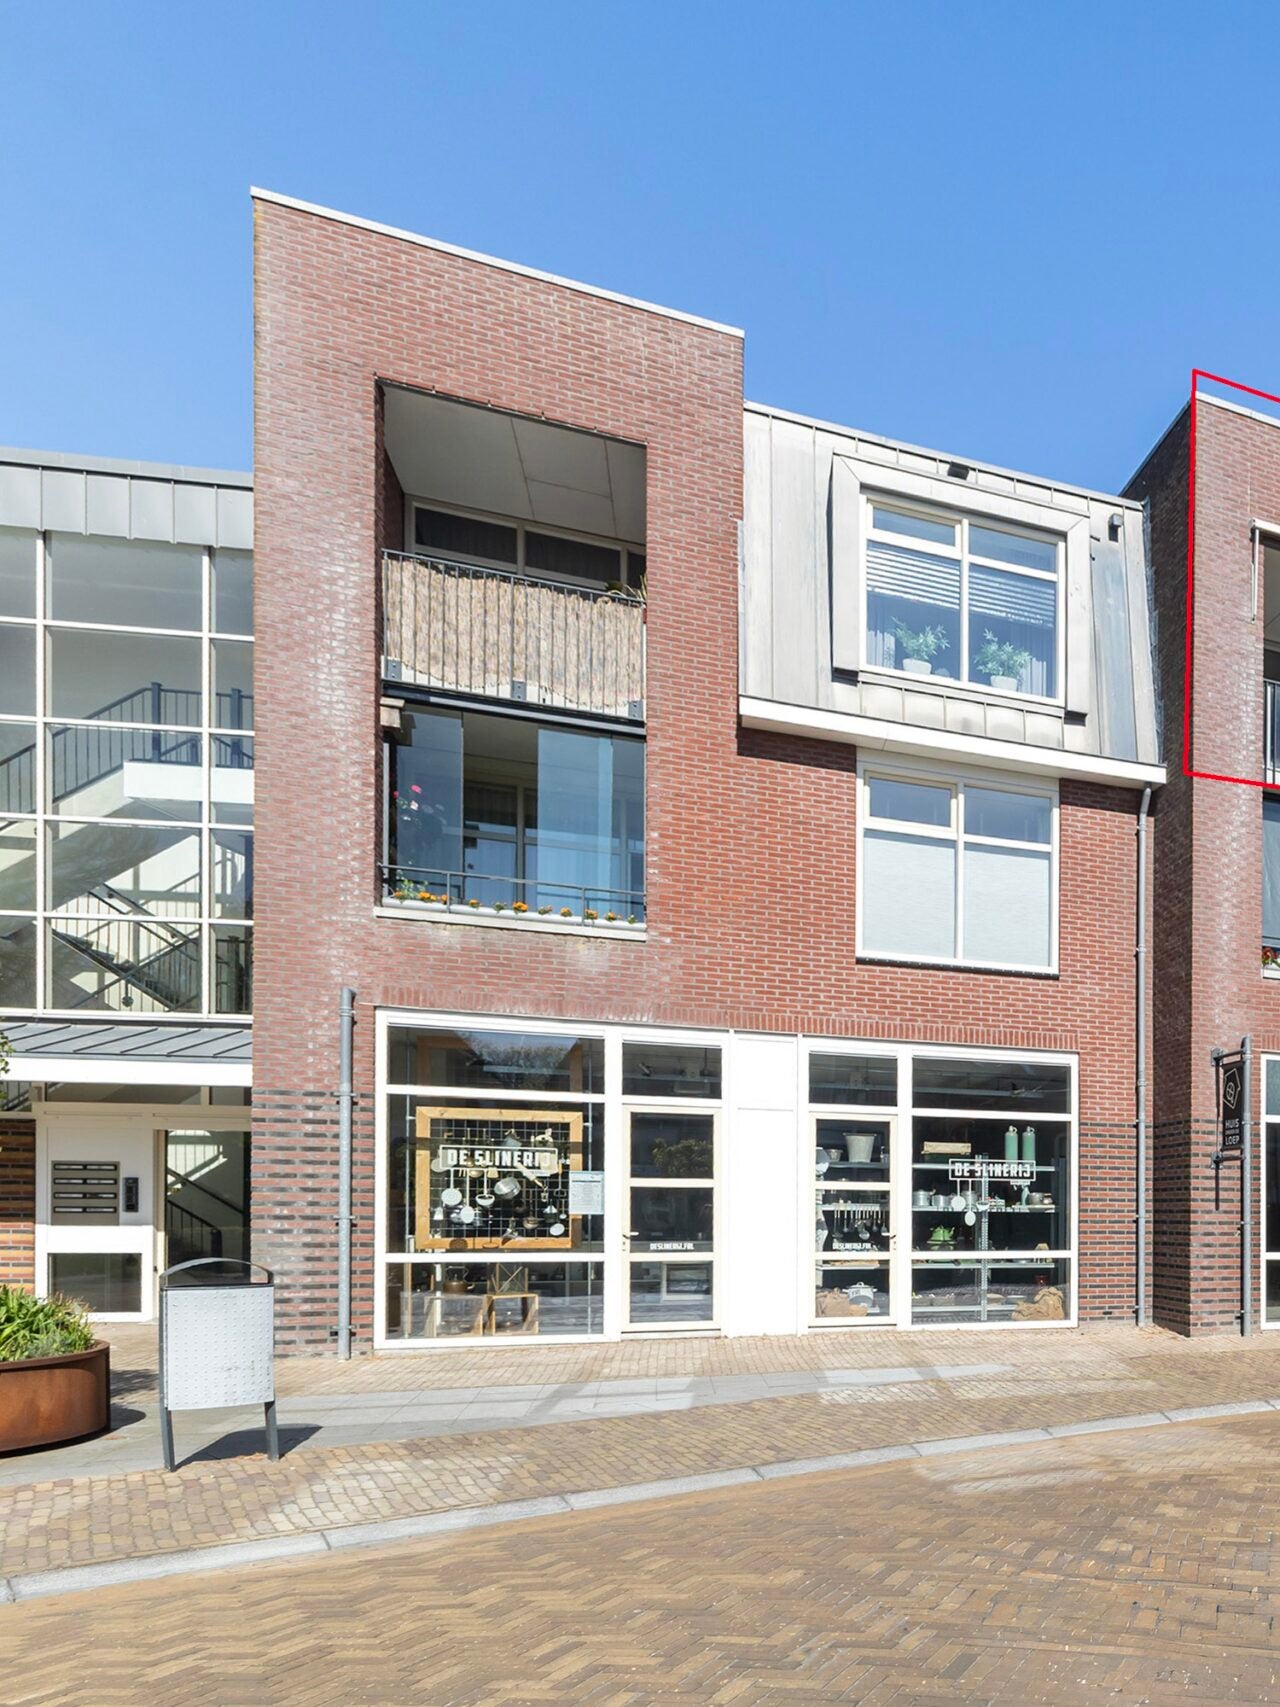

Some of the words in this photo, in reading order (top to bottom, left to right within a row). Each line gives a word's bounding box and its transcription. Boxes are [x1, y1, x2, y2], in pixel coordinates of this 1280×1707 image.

[447, 1149, 468, 1166] DE
[954, 1162, 971, 1176] DE
[975, 1163, 1031, 1177] SLINERIJ
